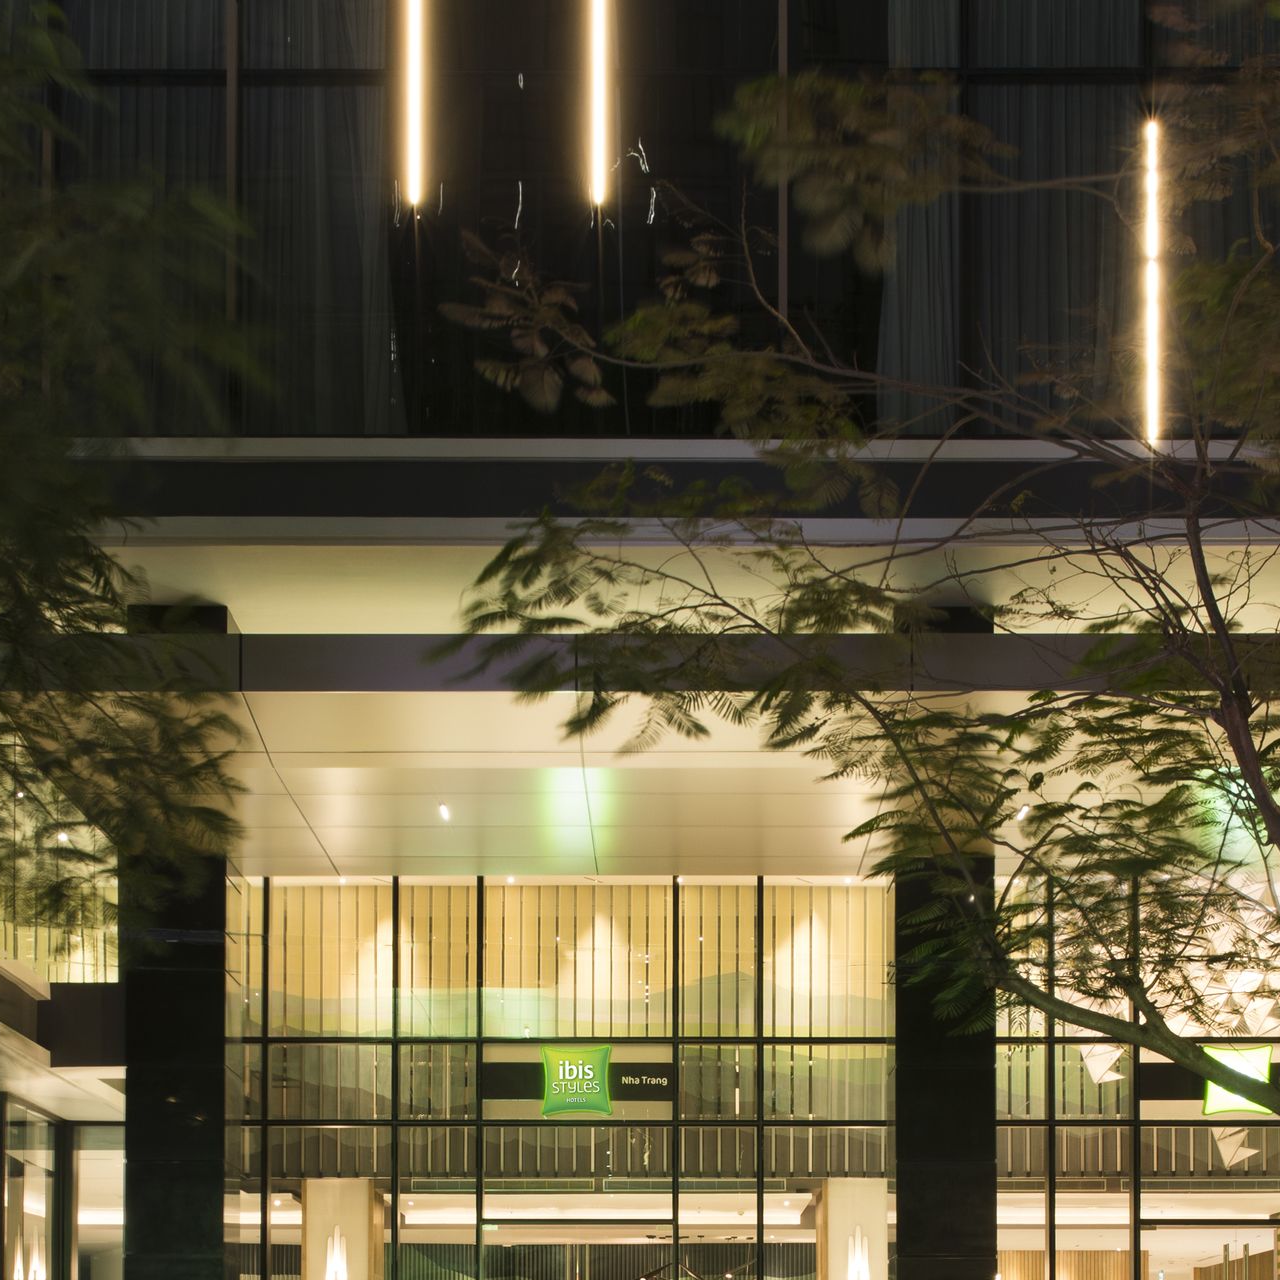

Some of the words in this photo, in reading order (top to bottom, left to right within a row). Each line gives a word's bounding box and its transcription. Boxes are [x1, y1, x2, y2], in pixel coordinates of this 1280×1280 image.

[558, 1060, 594, 1080] ibis
[621, 1076, 640, 1085] Nha
[641, 1076, 668, 1086] Trang
